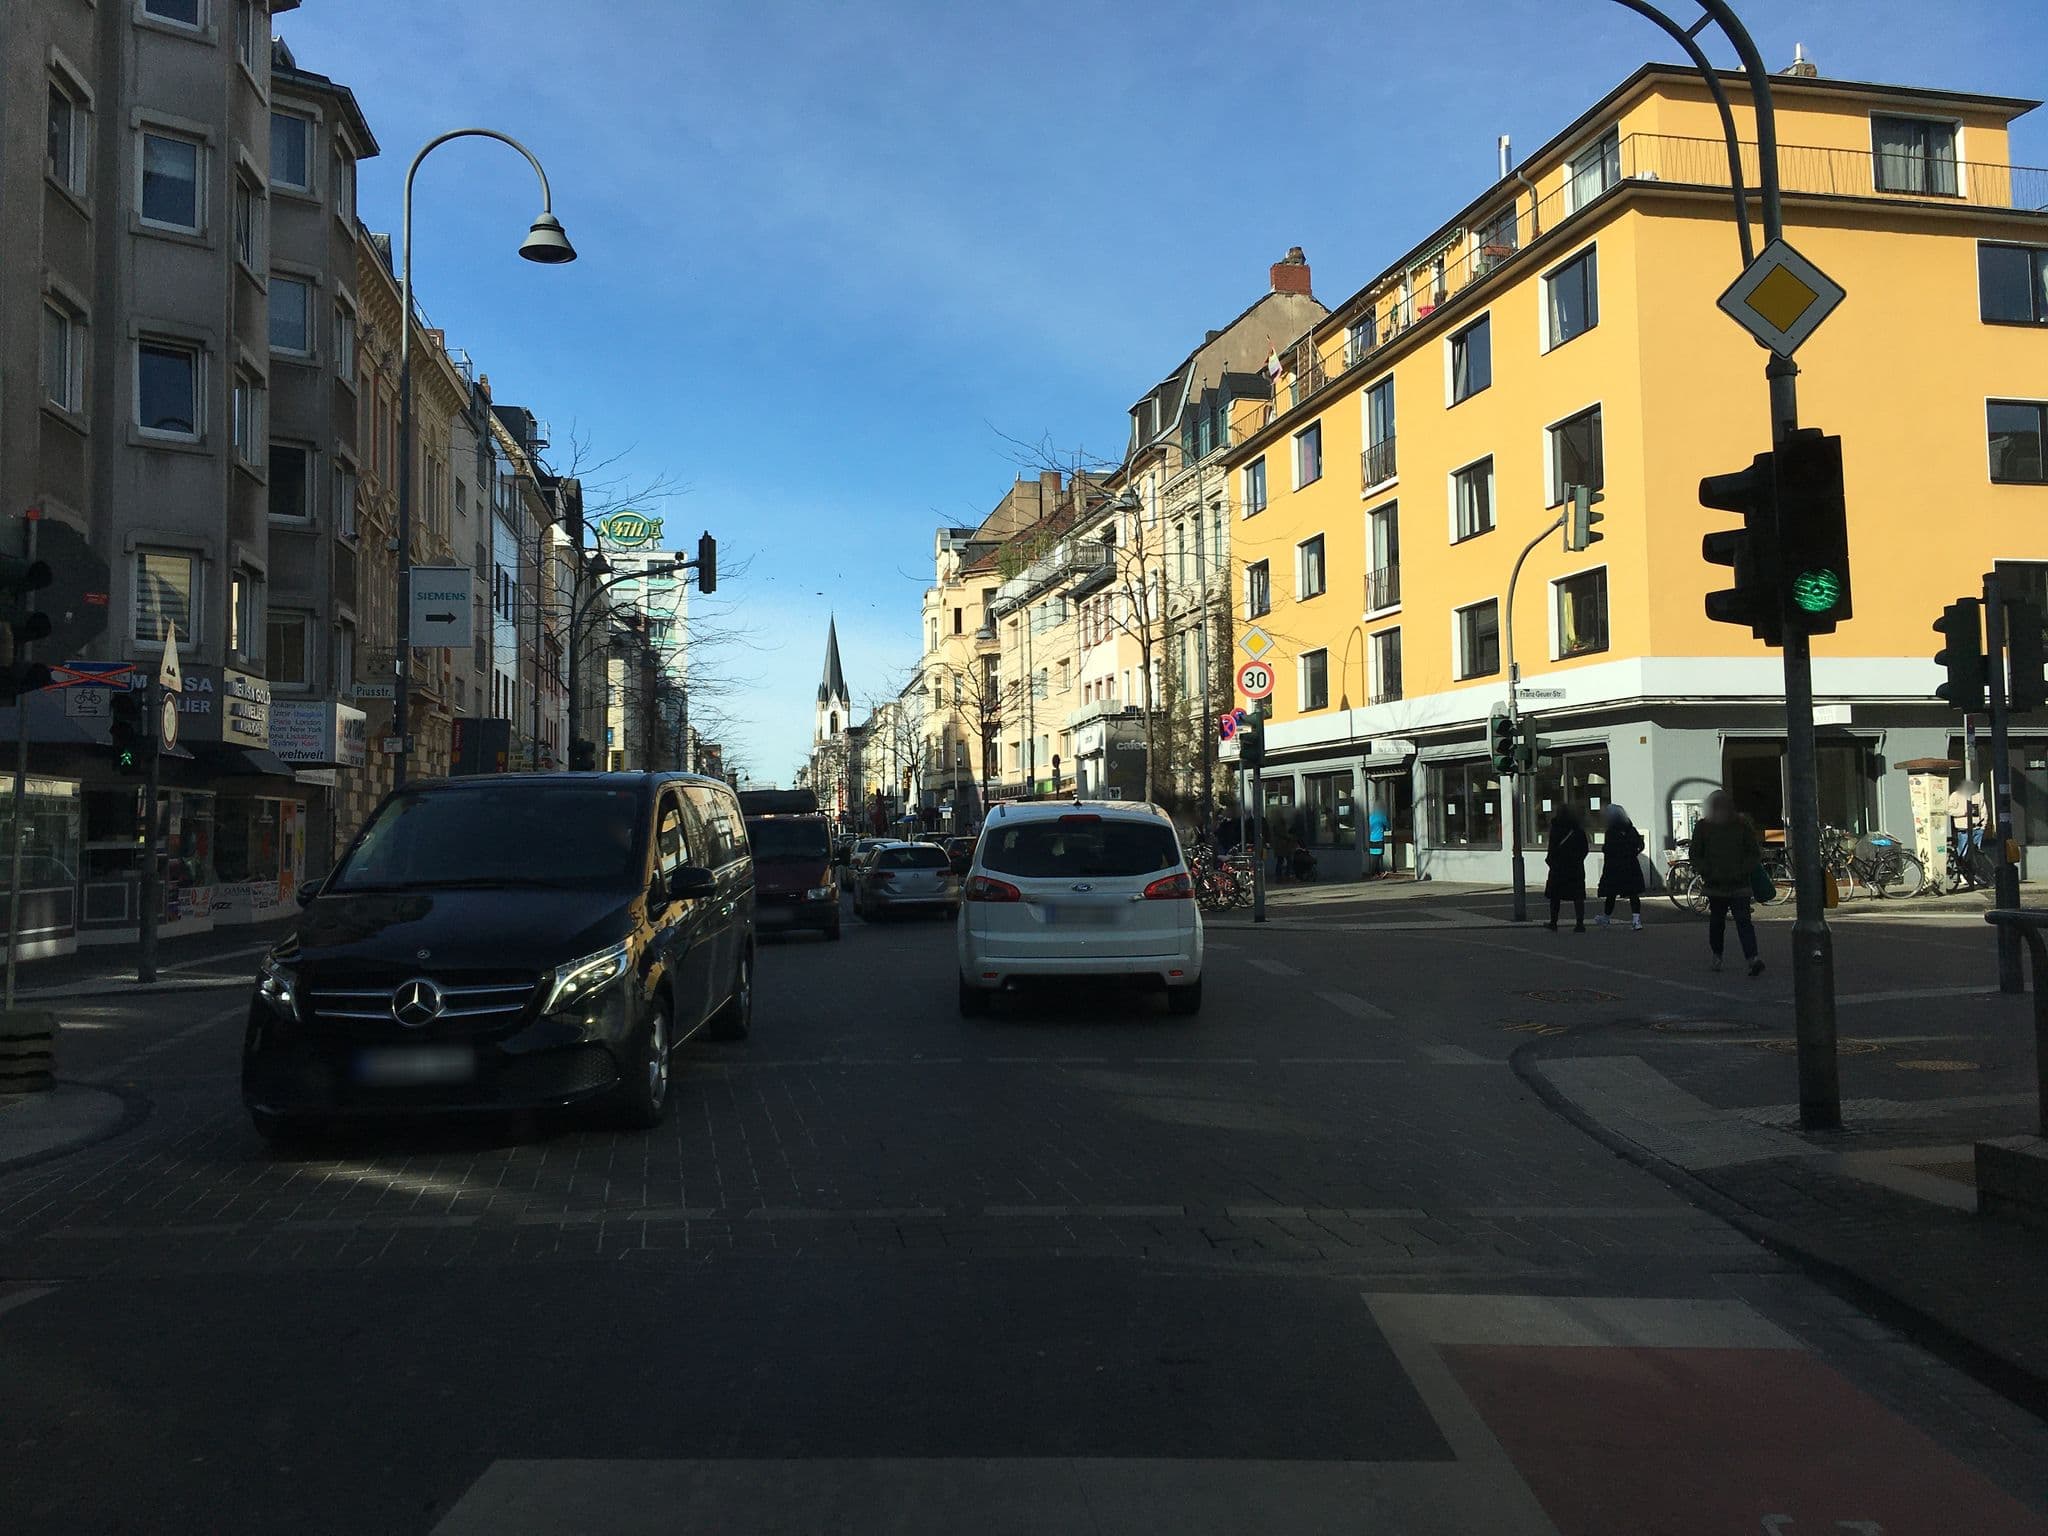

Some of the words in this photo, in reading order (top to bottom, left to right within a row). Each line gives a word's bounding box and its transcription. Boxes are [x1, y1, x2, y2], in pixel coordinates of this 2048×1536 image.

[417, 592, 466, 600] SIEMENS
[1245, 672, 1266, 688] 30
[356, 684, 391, 697] Piusstr.
[279, 750, 324, 760] weltweit
